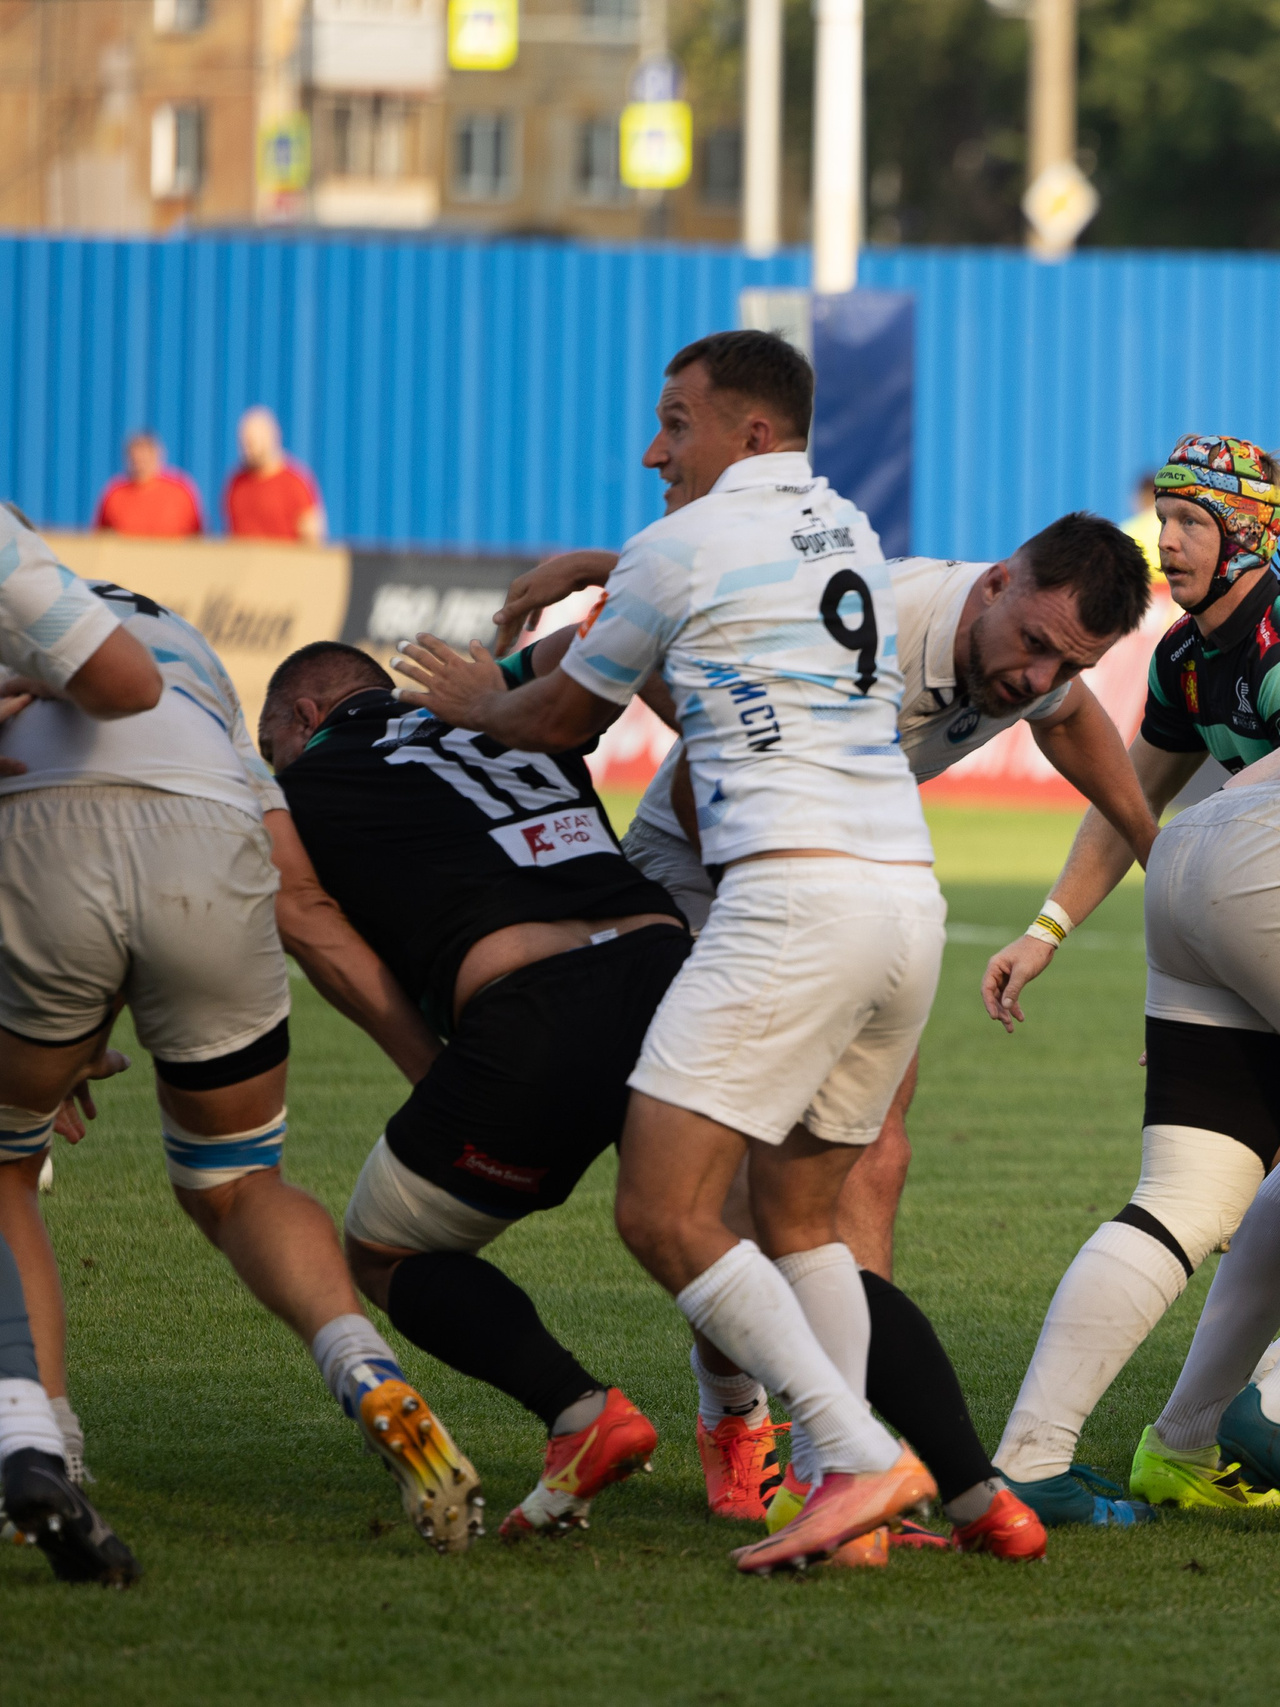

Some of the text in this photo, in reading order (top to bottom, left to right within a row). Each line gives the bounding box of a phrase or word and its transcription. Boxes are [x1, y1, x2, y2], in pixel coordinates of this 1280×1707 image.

[819, 568, 878, 696] 9
[553, 814, 593, 834] АГАТ
[559, 831, 590, 845] РФ
